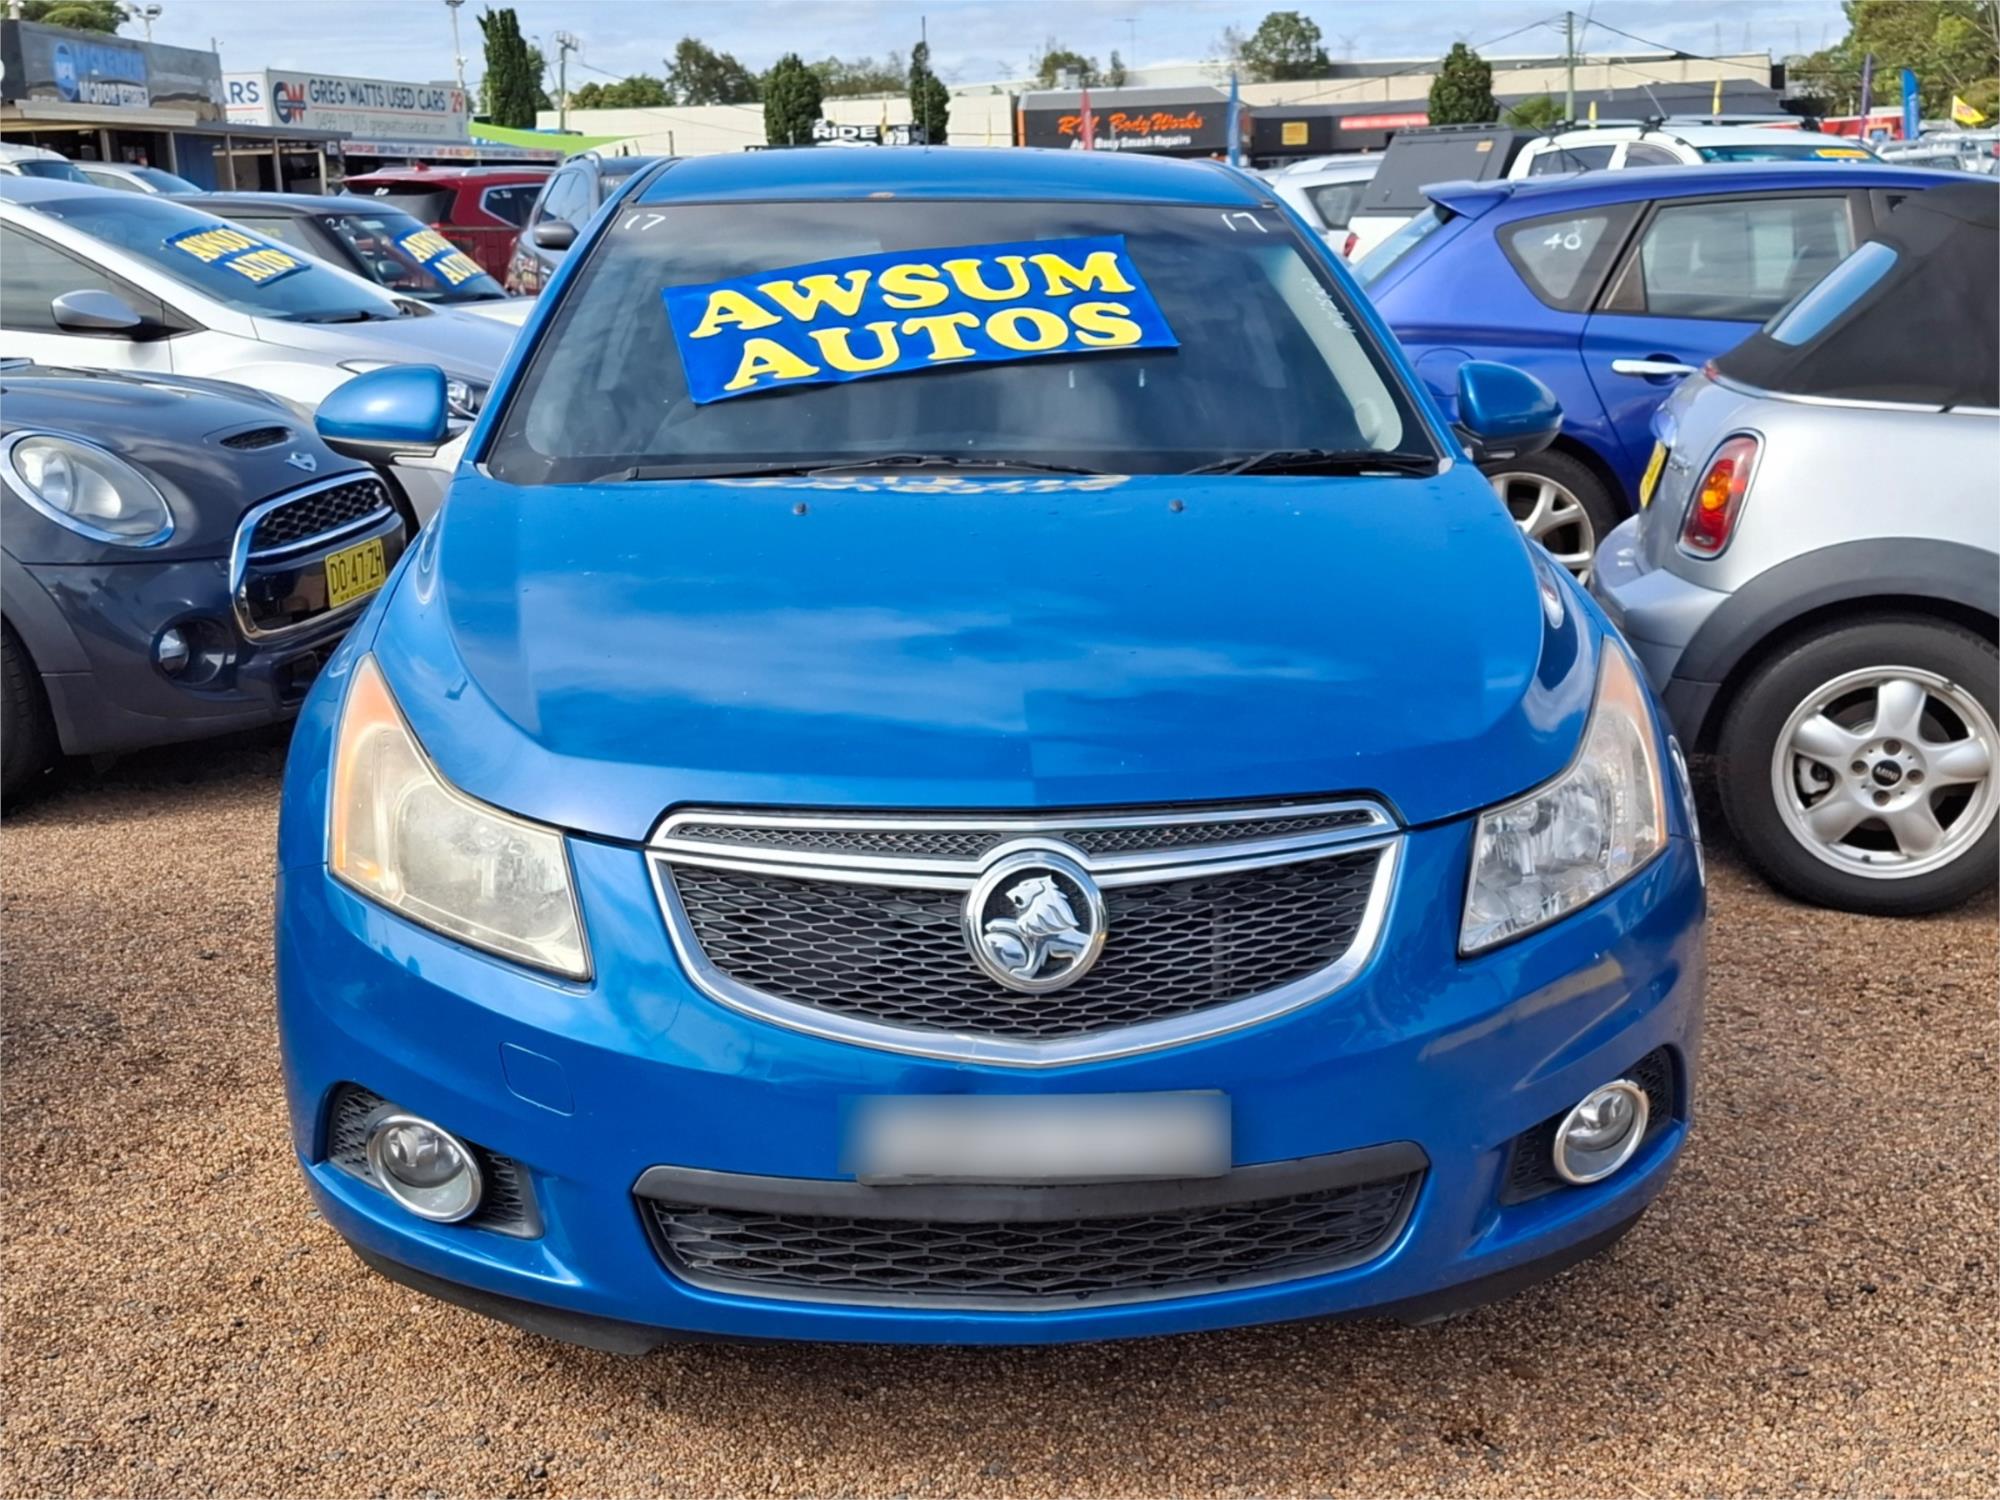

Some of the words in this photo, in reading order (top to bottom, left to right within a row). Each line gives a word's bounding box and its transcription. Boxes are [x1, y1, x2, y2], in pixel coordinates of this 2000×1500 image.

[78, 81, 120, 105] MOTOR
[223, 81, 260, 104] RS
[309, 79, 345, 104] GREG
[347, 83, 384, 107] WATTS
[386, 86, 415, 110] USED
[418, 88, 446, 112] CARS
[812, 126, 878, 139] RIDE
[1120, 136, 1153, 149] Smash
[1153, 134, 1192, 149] Repairs
[624, 213, 667, 232] 17
[1220, 211, 1269, 234] 17
[1543, 232, 1582, 251] 40
[689, 251, 1136, 339] AWSUM
[723, 302, 1143, 391] AUTOS
